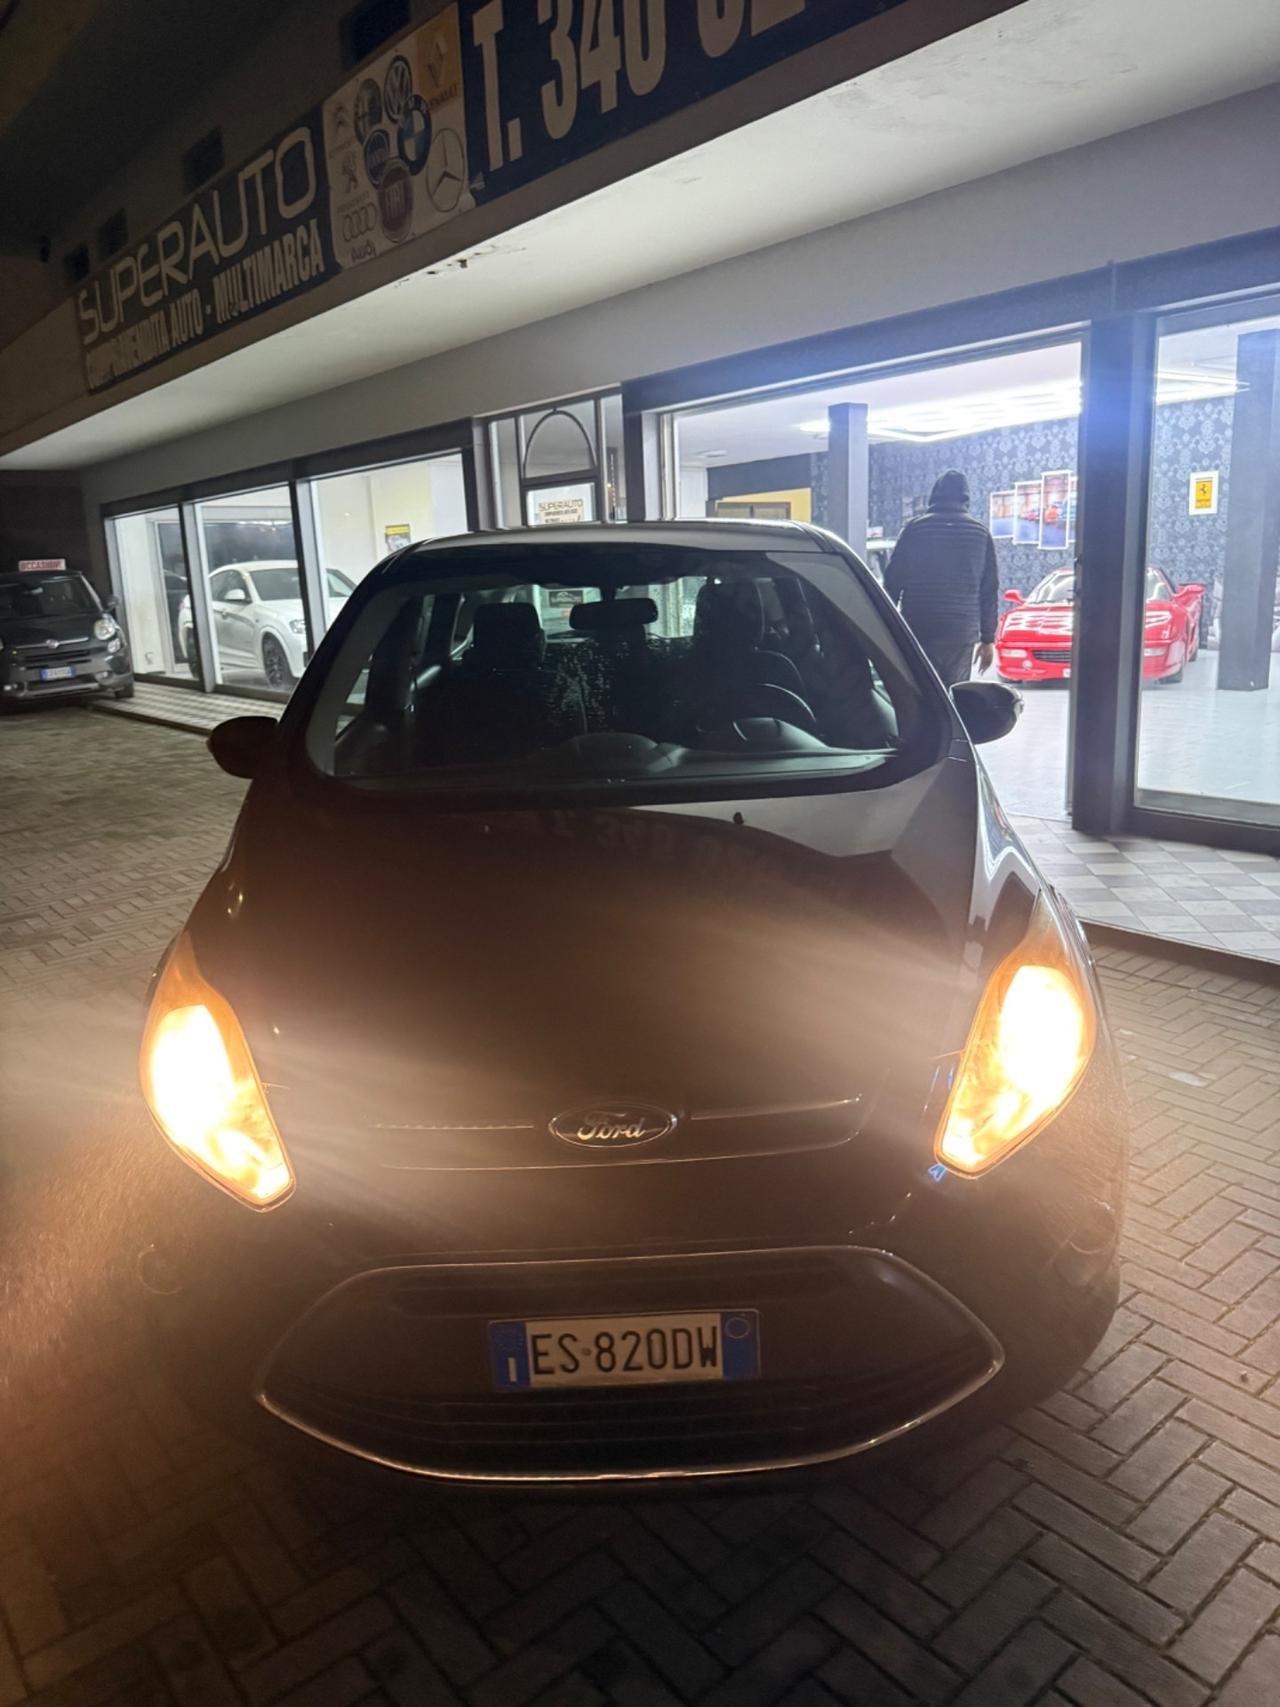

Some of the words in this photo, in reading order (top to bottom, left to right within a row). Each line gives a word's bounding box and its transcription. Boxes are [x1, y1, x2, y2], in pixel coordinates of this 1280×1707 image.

[473, 0, 522, 171] T.
[537, 0, 667, 139] 340
[78, 126, 317, 345] SUPERAUTO
[170, 288, 204, 349] AUTO
[213, 218, 325, 324] MULTIMARCA
[577, 1111, 646, 1140] Ford
